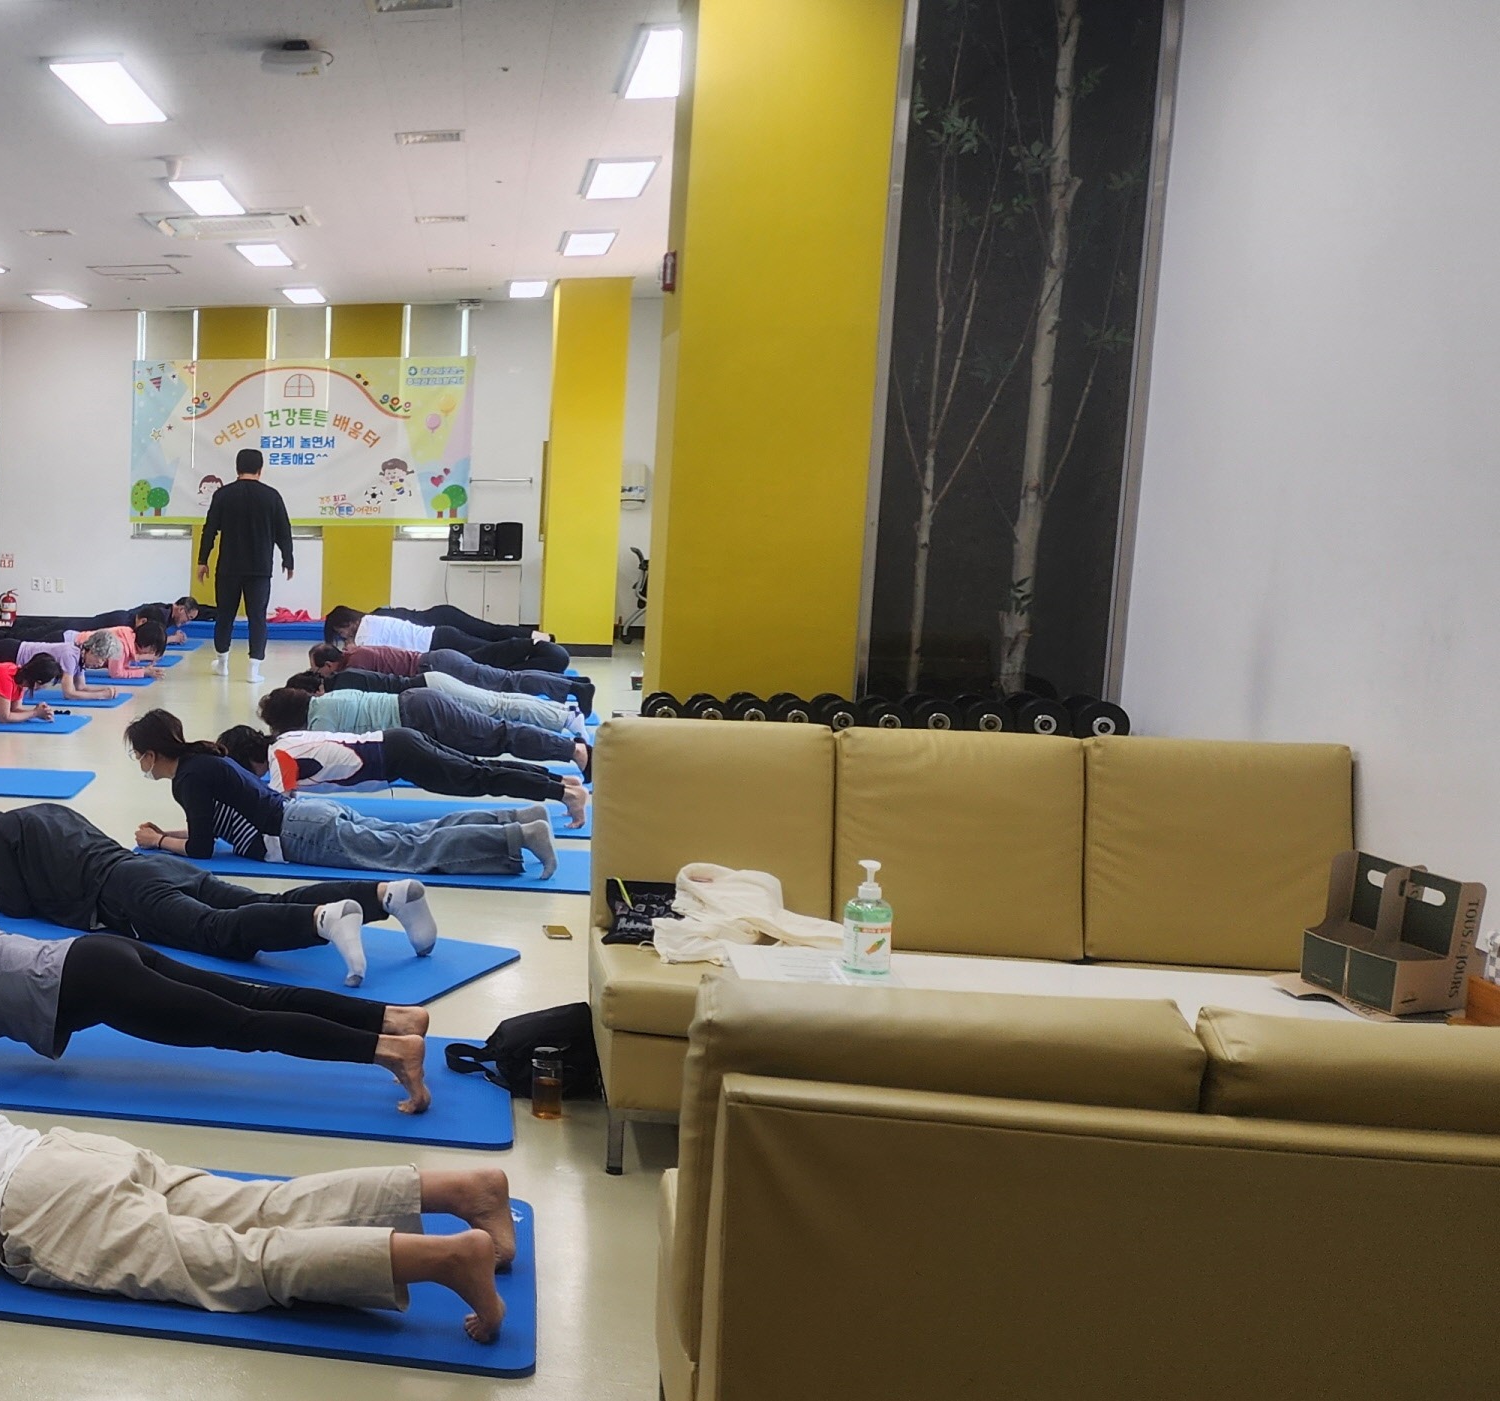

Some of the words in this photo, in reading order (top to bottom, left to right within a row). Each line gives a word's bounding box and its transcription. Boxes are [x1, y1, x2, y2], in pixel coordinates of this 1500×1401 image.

[214, 413, 261, 446] 어린이
[264, 408, 329, 428] 건강튼튼
[332, 413, 381, 448] 배움터
[260, 435, 295, 449] 즐겁게
[300, 435, 335, 449] 놀면서
[1462, 900, 1479, 938] TOUS
[1448, 956, 1468, 998] JOURS
